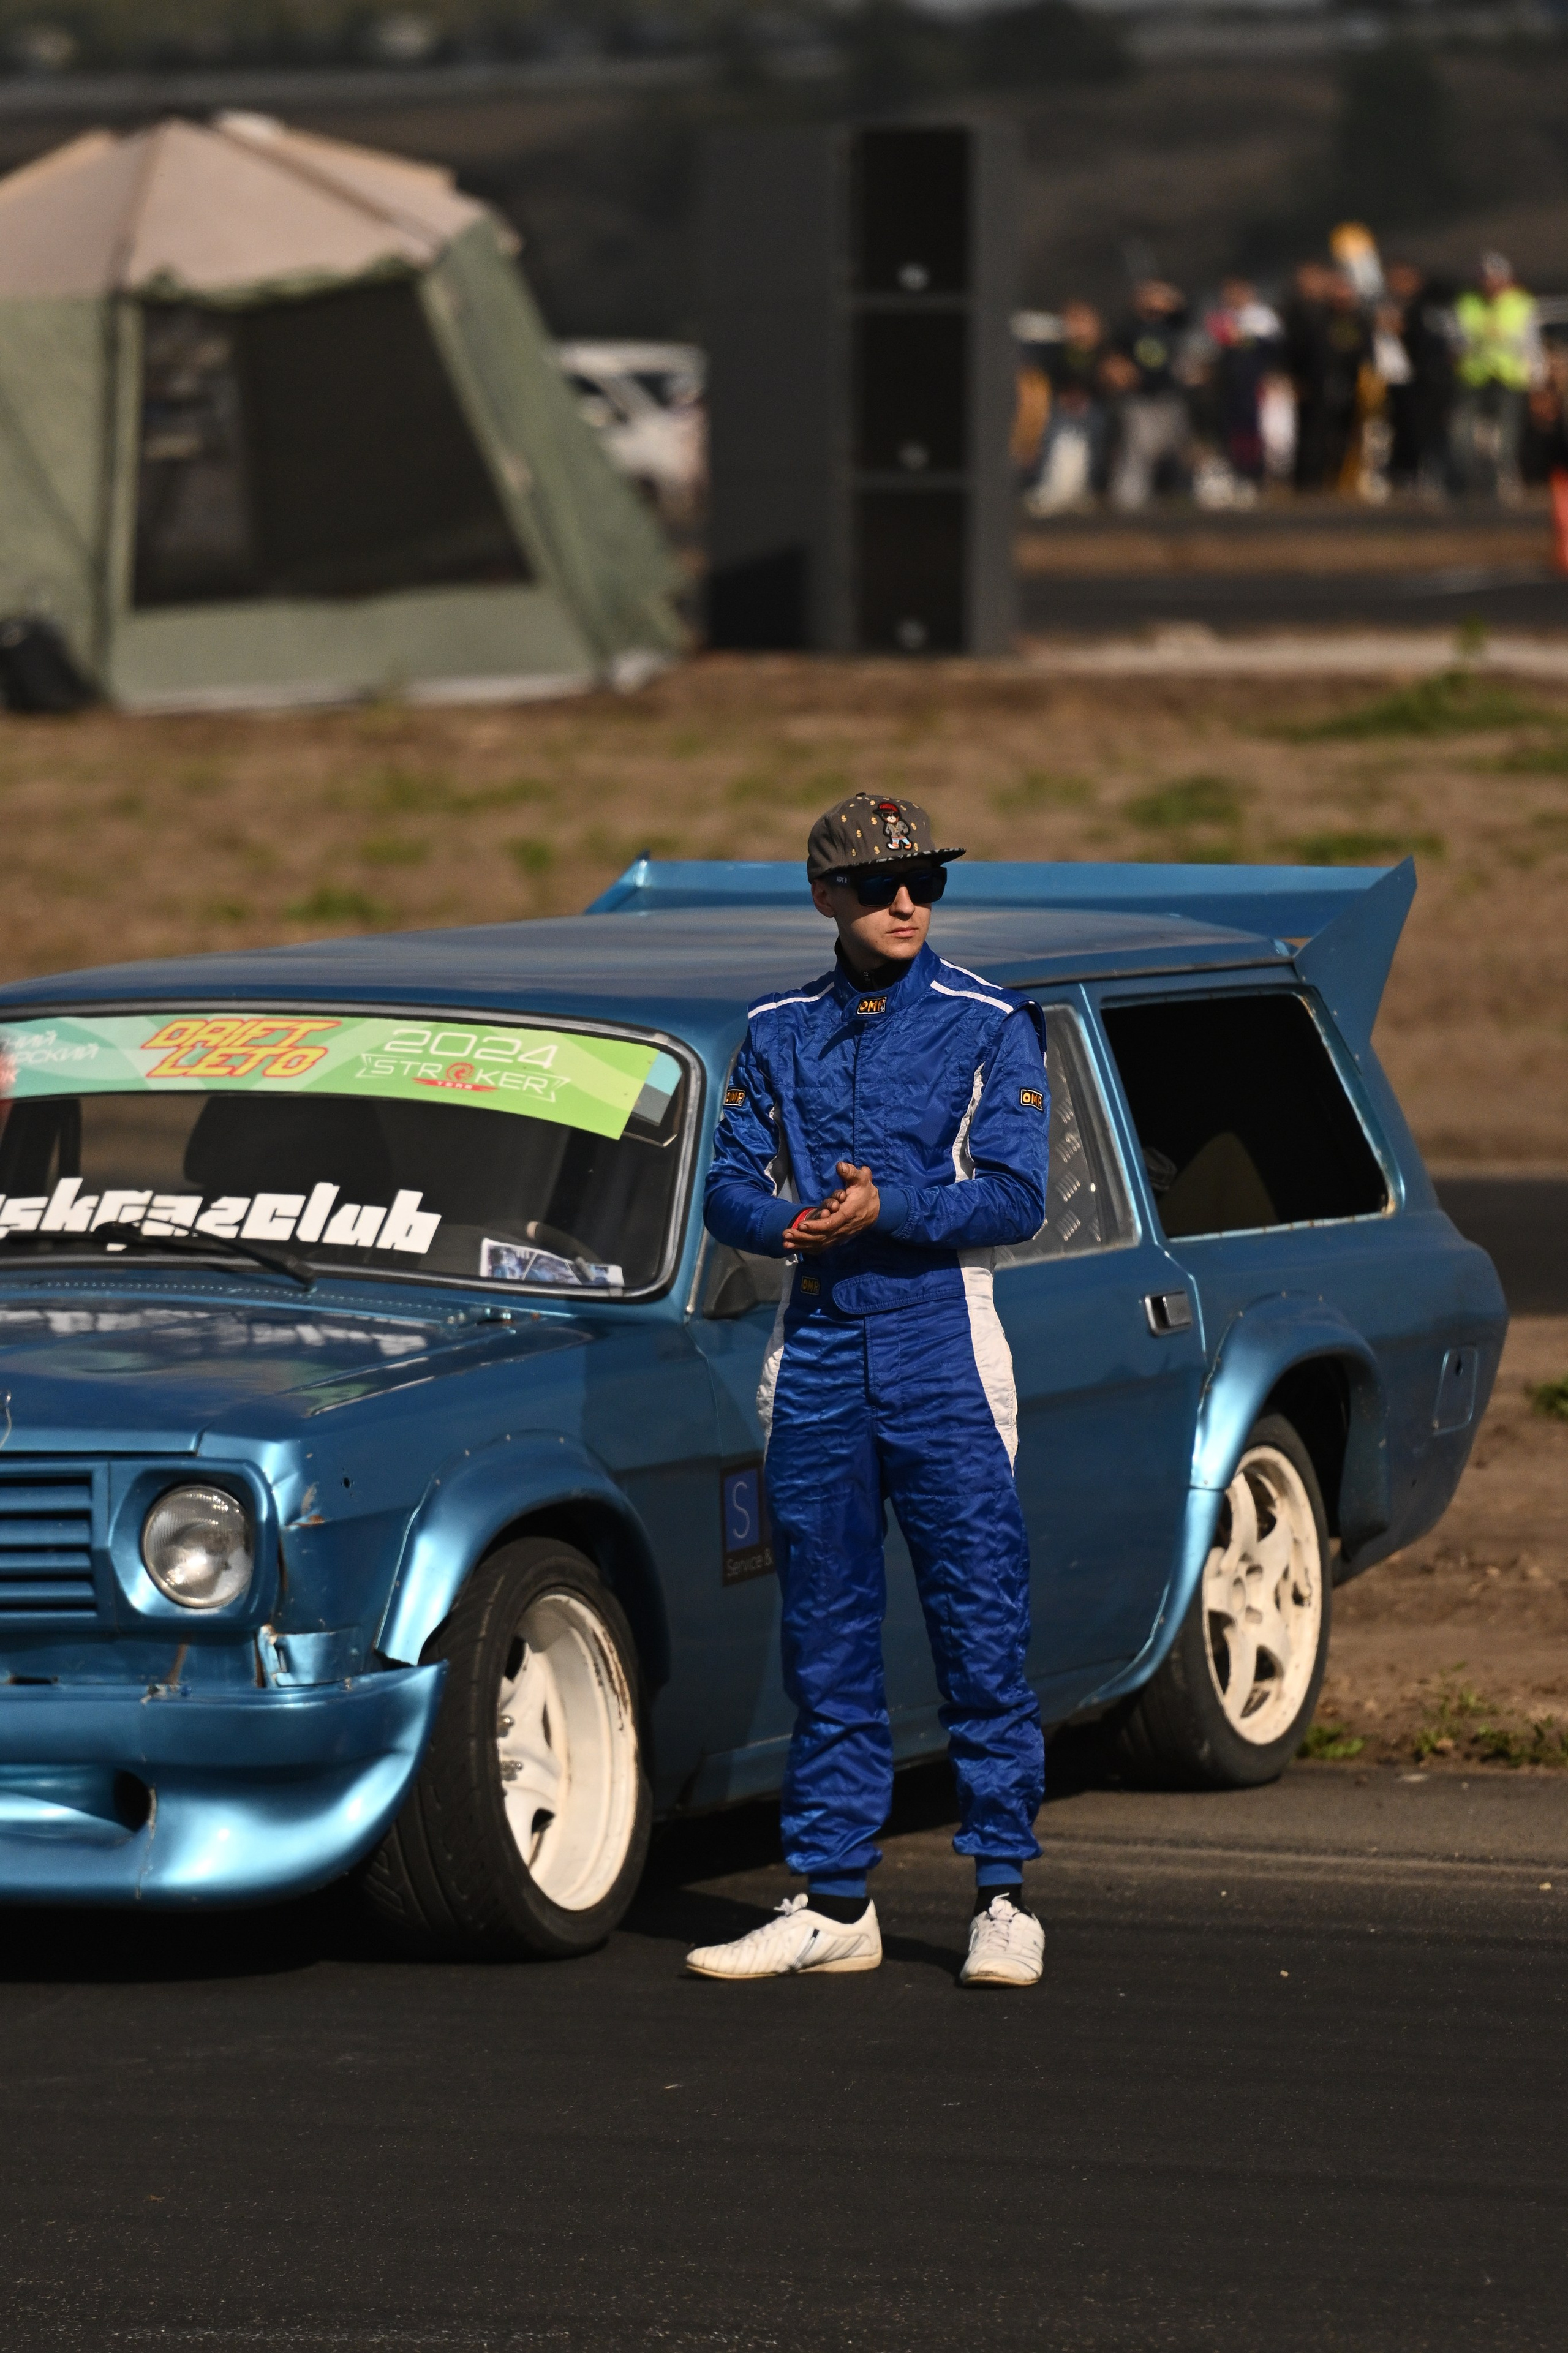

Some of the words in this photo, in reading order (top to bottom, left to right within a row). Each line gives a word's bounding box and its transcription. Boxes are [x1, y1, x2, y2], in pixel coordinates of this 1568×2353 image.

[859, 999, 885, 1012] OMP
[140, 1018, 342, 1049] DRIFT
[384, 1028, 558, 1069] 2024
[145, 1046, 328, 1078] LETO
[1022, 1092, 1042, 1107] OMP
[732, 1481, 750, 1540] S
